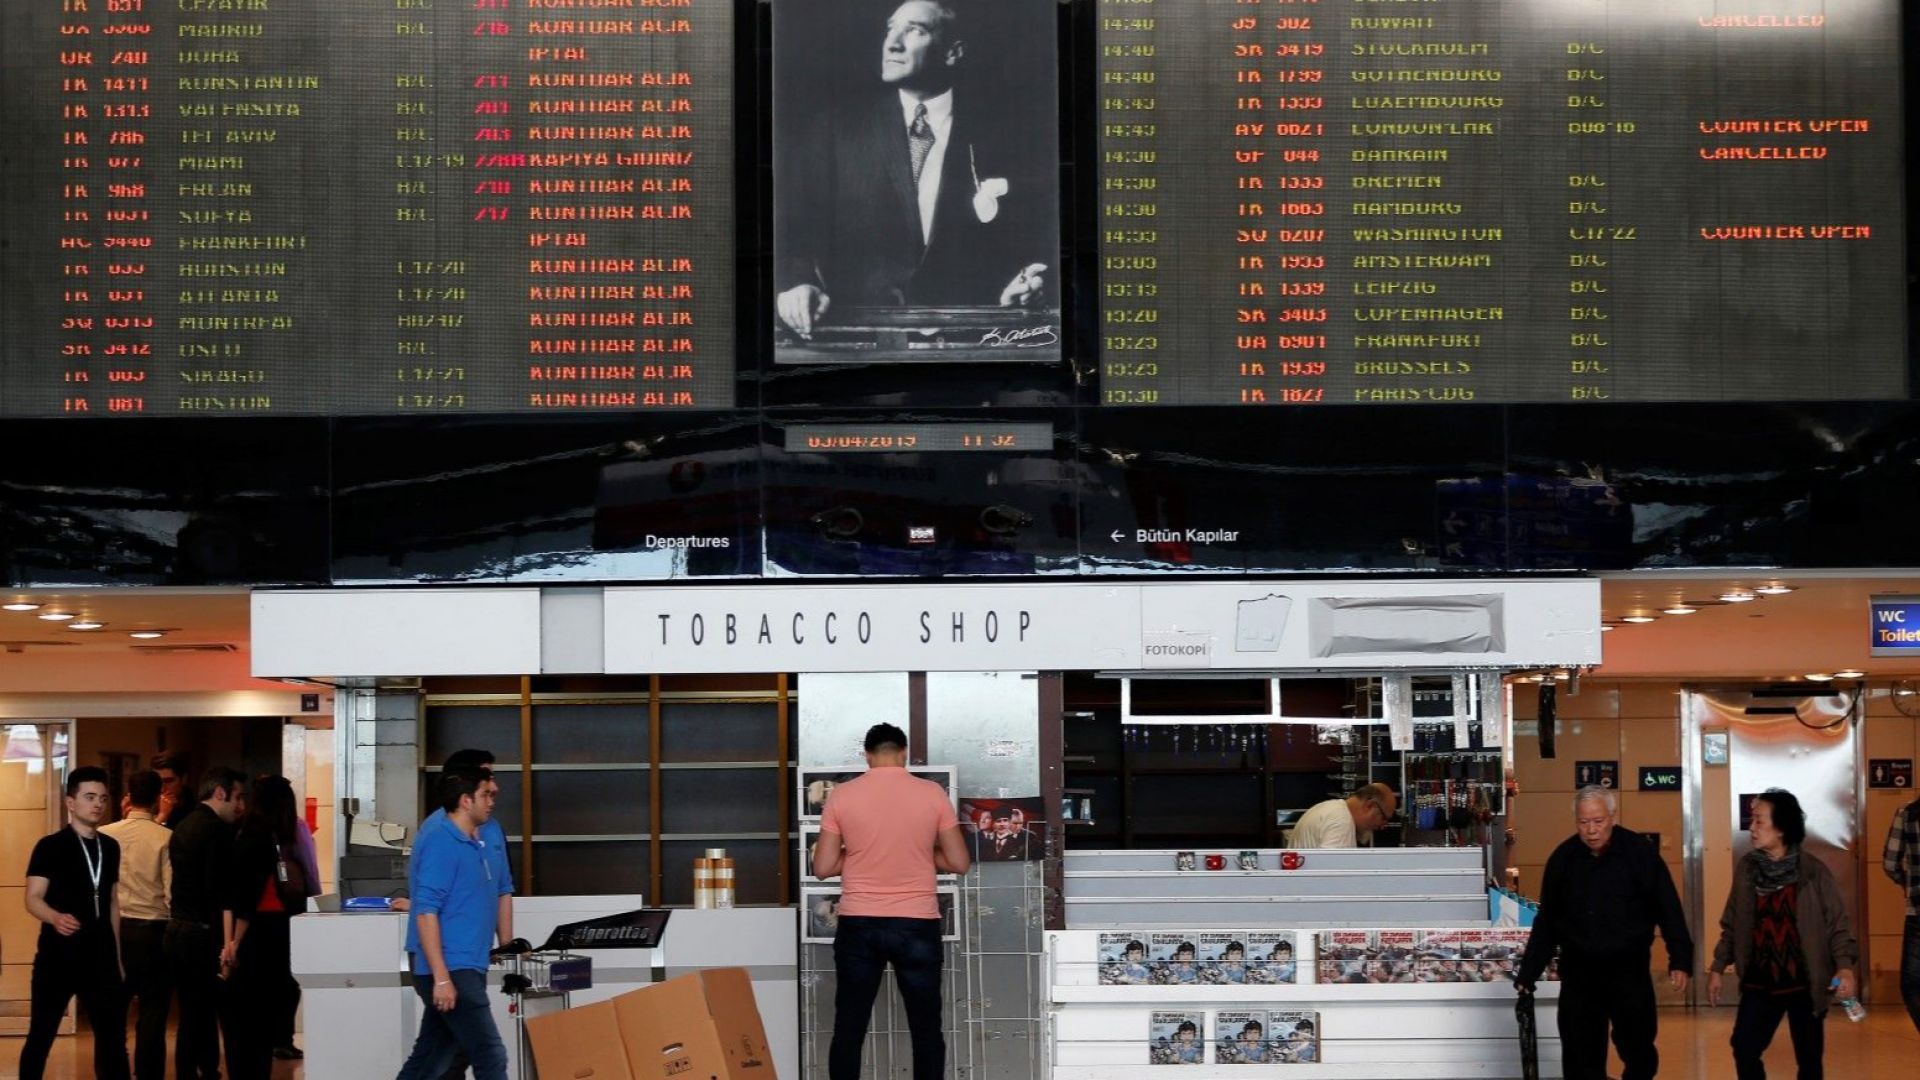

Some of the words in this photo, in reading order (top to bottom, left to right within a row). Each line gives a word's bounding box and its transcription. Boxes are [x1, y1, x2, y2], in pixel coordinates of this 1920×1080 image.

[1699, 15, 1827, 29] CANCELLED
[1352, 43, 1488, 55] STOCKHOLM
[1352, 96, 1504, 109] LUXEMBOURG
[1699, 119, 1803, 134] COUNTER
[1809, 118, 1869, 133] OPEN
[1700, 146, 1828, 161] CANCELLED
[179, 156, 243, 169] MIAMI
[1352, 175, 1441, 188] BREMEN
[1353, 202, 1461, 215] HAMBURG
[1353, 228, 1503, 241] WASHINGTON
[1701, 225, 1804, 240] COUNTER
[1811, 224, 1871, 239] OPEN
[1353, 255, 1491, 268] AMSTERDAM
[1353, 282, 1437, 295] LEIPZIG
[1355, 307, 1503, 321] COPENHAGEN
[1354, 334, 1480, 347] FRANKFURT
[1355, 361, 1471, 375] BRUSSELS
[645, 534, 730, 550] Departures
[1136, 529, 1181, 543] Bütün
[1186, 528, 1239, 546] Kapılar
[1878, 610, 1906, 622] WC
[658, 612, 871, 645] TOBACCO
[919, 611, 1031, 643] SHOP
[1145, 643, 1206, 656] FOTOKOPİ
[1658, 775, 1676, 785] WC
